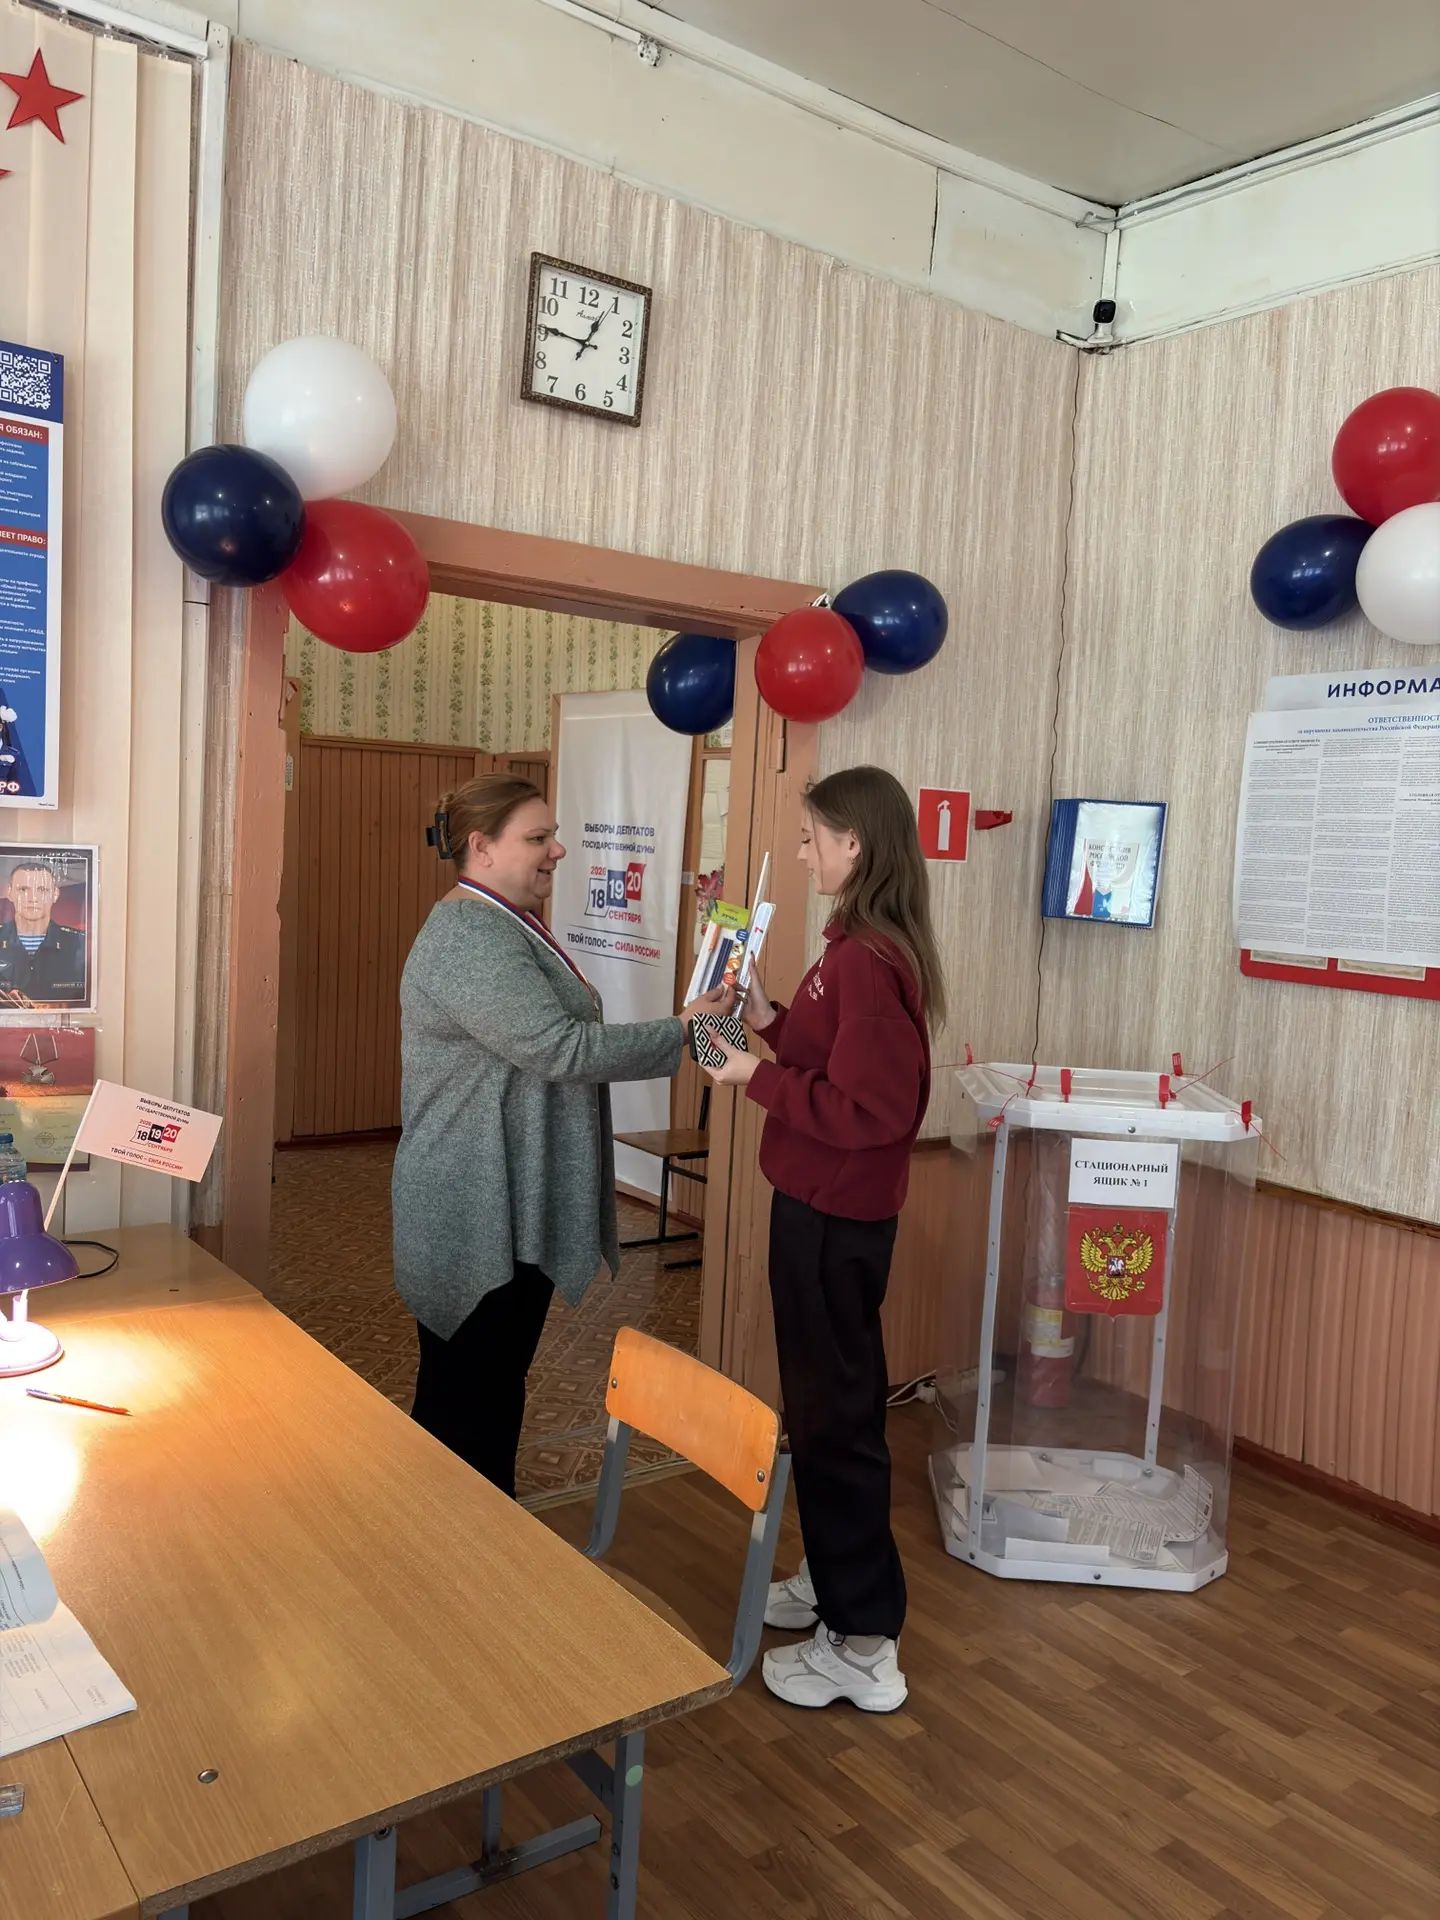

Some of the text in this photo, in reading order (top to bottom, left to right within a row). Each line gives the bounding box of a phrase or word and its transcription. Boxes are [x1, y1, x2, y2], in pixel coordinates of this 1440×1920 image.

[551, 278, 568, 299] 11
[578, 286, 599, 308] 12
[539, 296, 558, 316] 10
[611, 297, 620, 314] 1
[538, 324, 549, 342] 9
[622, 320, 633, 338] 2
[535, 351, 546, 369] 8
[619, 347, 629, 364] 3
[547, 375, 558, 393] 7
[617, 374, 627, 391] 4
[575, 384, 586, 400] 6
[603, 391, 613, 407] 5
[6, 424, 43, 440] ОБЯЗАН:
[17, 533, 46, 545] ПРАВО:
[1327, 677, 1440, 698] ИНФОРМА
[584, 823, 655, 837] ВЫБОРЫ ДЕПУТАТОВ
[582, 840, 655, 854] ГОСУДАРСТВЕННОЙ ДУМЫ
[590, 866, 606, 876] 2026
[591, 871, 641, 909] 18 19 20
[608, 910, 642, 923] СЕНТЯБРЯ
[567, 933, 584, 944] ТВОЙ
[584, 937, 607, 948] ГОЛОС
[615, 941, 635, 953] СИЛА
[136, 1105, 176, 1120] ГОСУДАРСТВЕННОЙ
[140, 1097, 190, 1117] ВЫБОРЫ ДЕПУТАТОВ
[137, 1127, 177, 1140] 18 19 20
[111, 1147, 126, 1156] ТВОЙ
[126, 1151, 143, 1160] ГОЛОС
[148, 1157, 161, 1165] СИЛА
[1075, 1160, 1168, 1173] СТАЦИОНАРНЫЙ
[1093, 1177, 1148, 1187] ЯЩИК № 1
